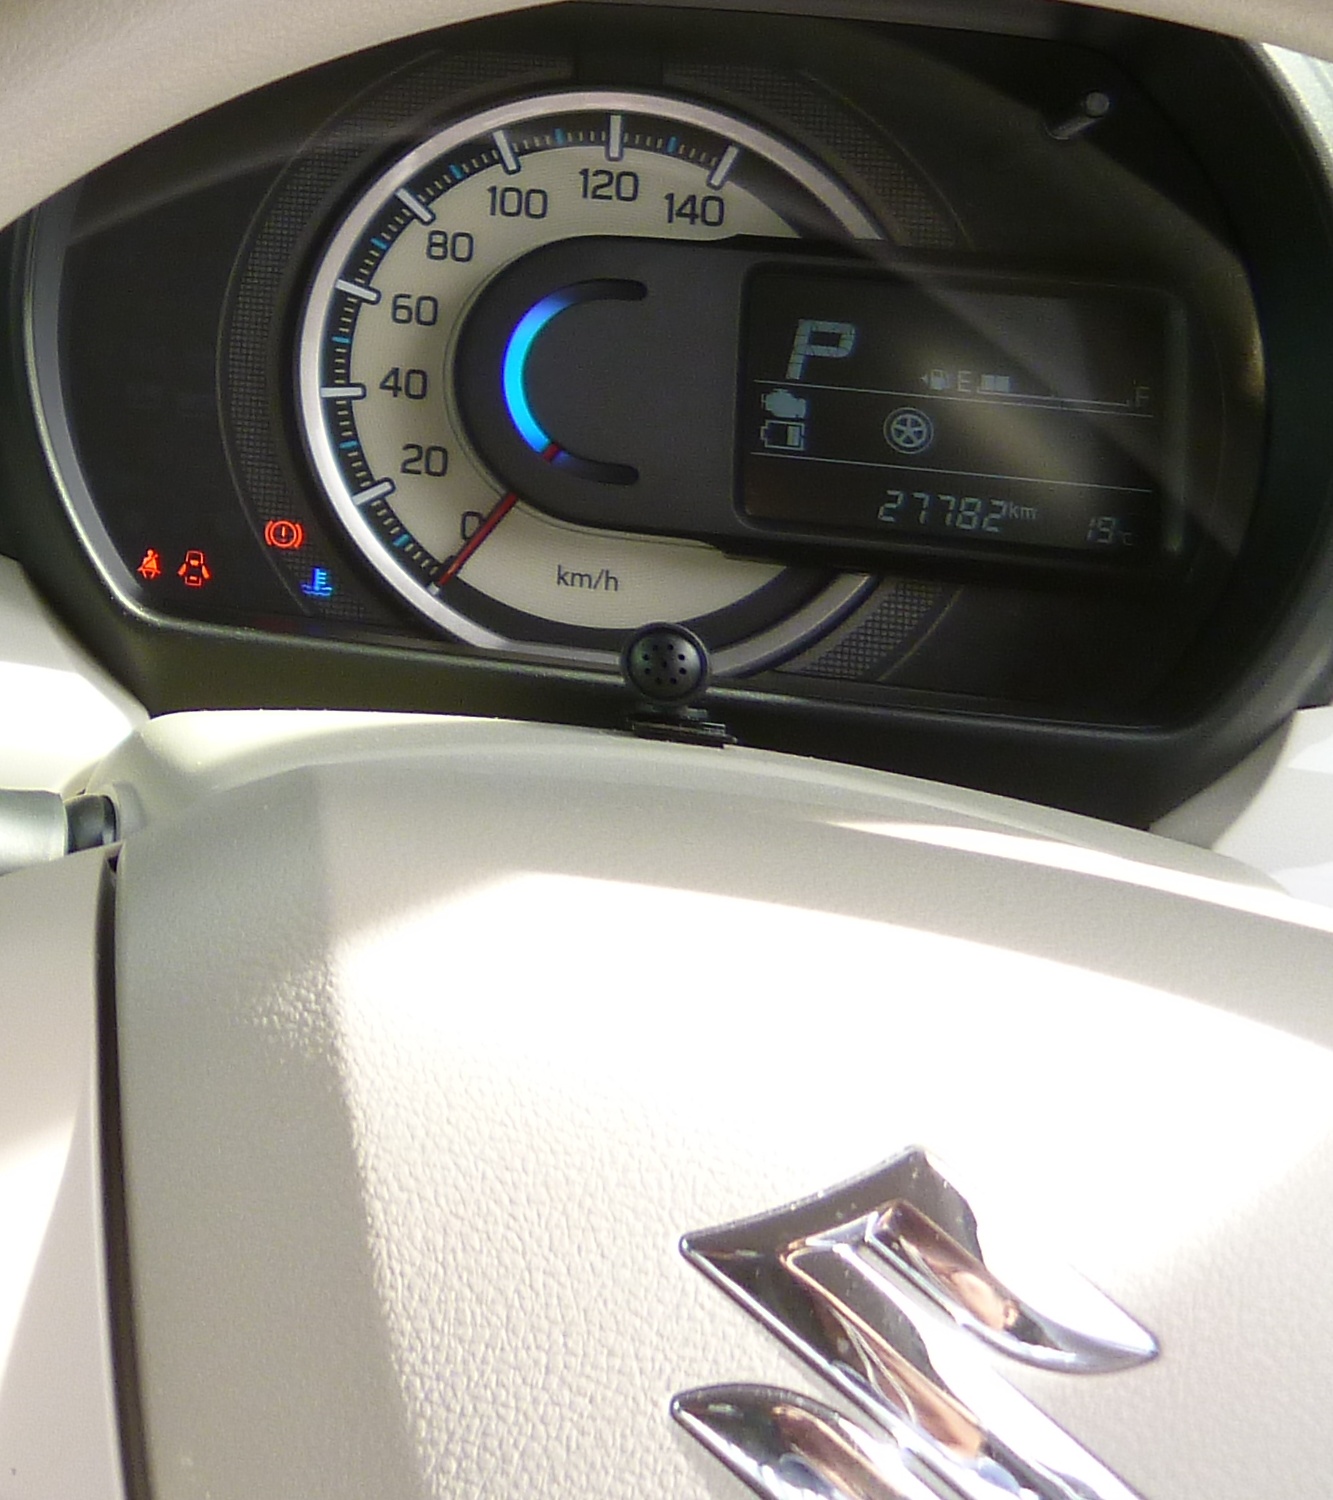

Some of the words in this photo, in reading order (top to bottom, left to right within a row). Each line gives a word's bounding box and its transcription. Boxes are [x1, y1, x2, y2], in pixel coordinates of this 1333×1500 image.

[486, 185, 550, 220] 100
[578, 167, 641, 203] 120
[663, 193, 726, 228] 140
[424, 230, 475, 264] 80
[389, 293, 439, 327] 60
[784, 318, 859, 381] P
[378, 366, 428, 401] 40
[957, 370, 972, 394] E
[399, 443, 449, 478] 20
[460, 510, 488, 542] 0
[556, 563, 620, 593] km/h
